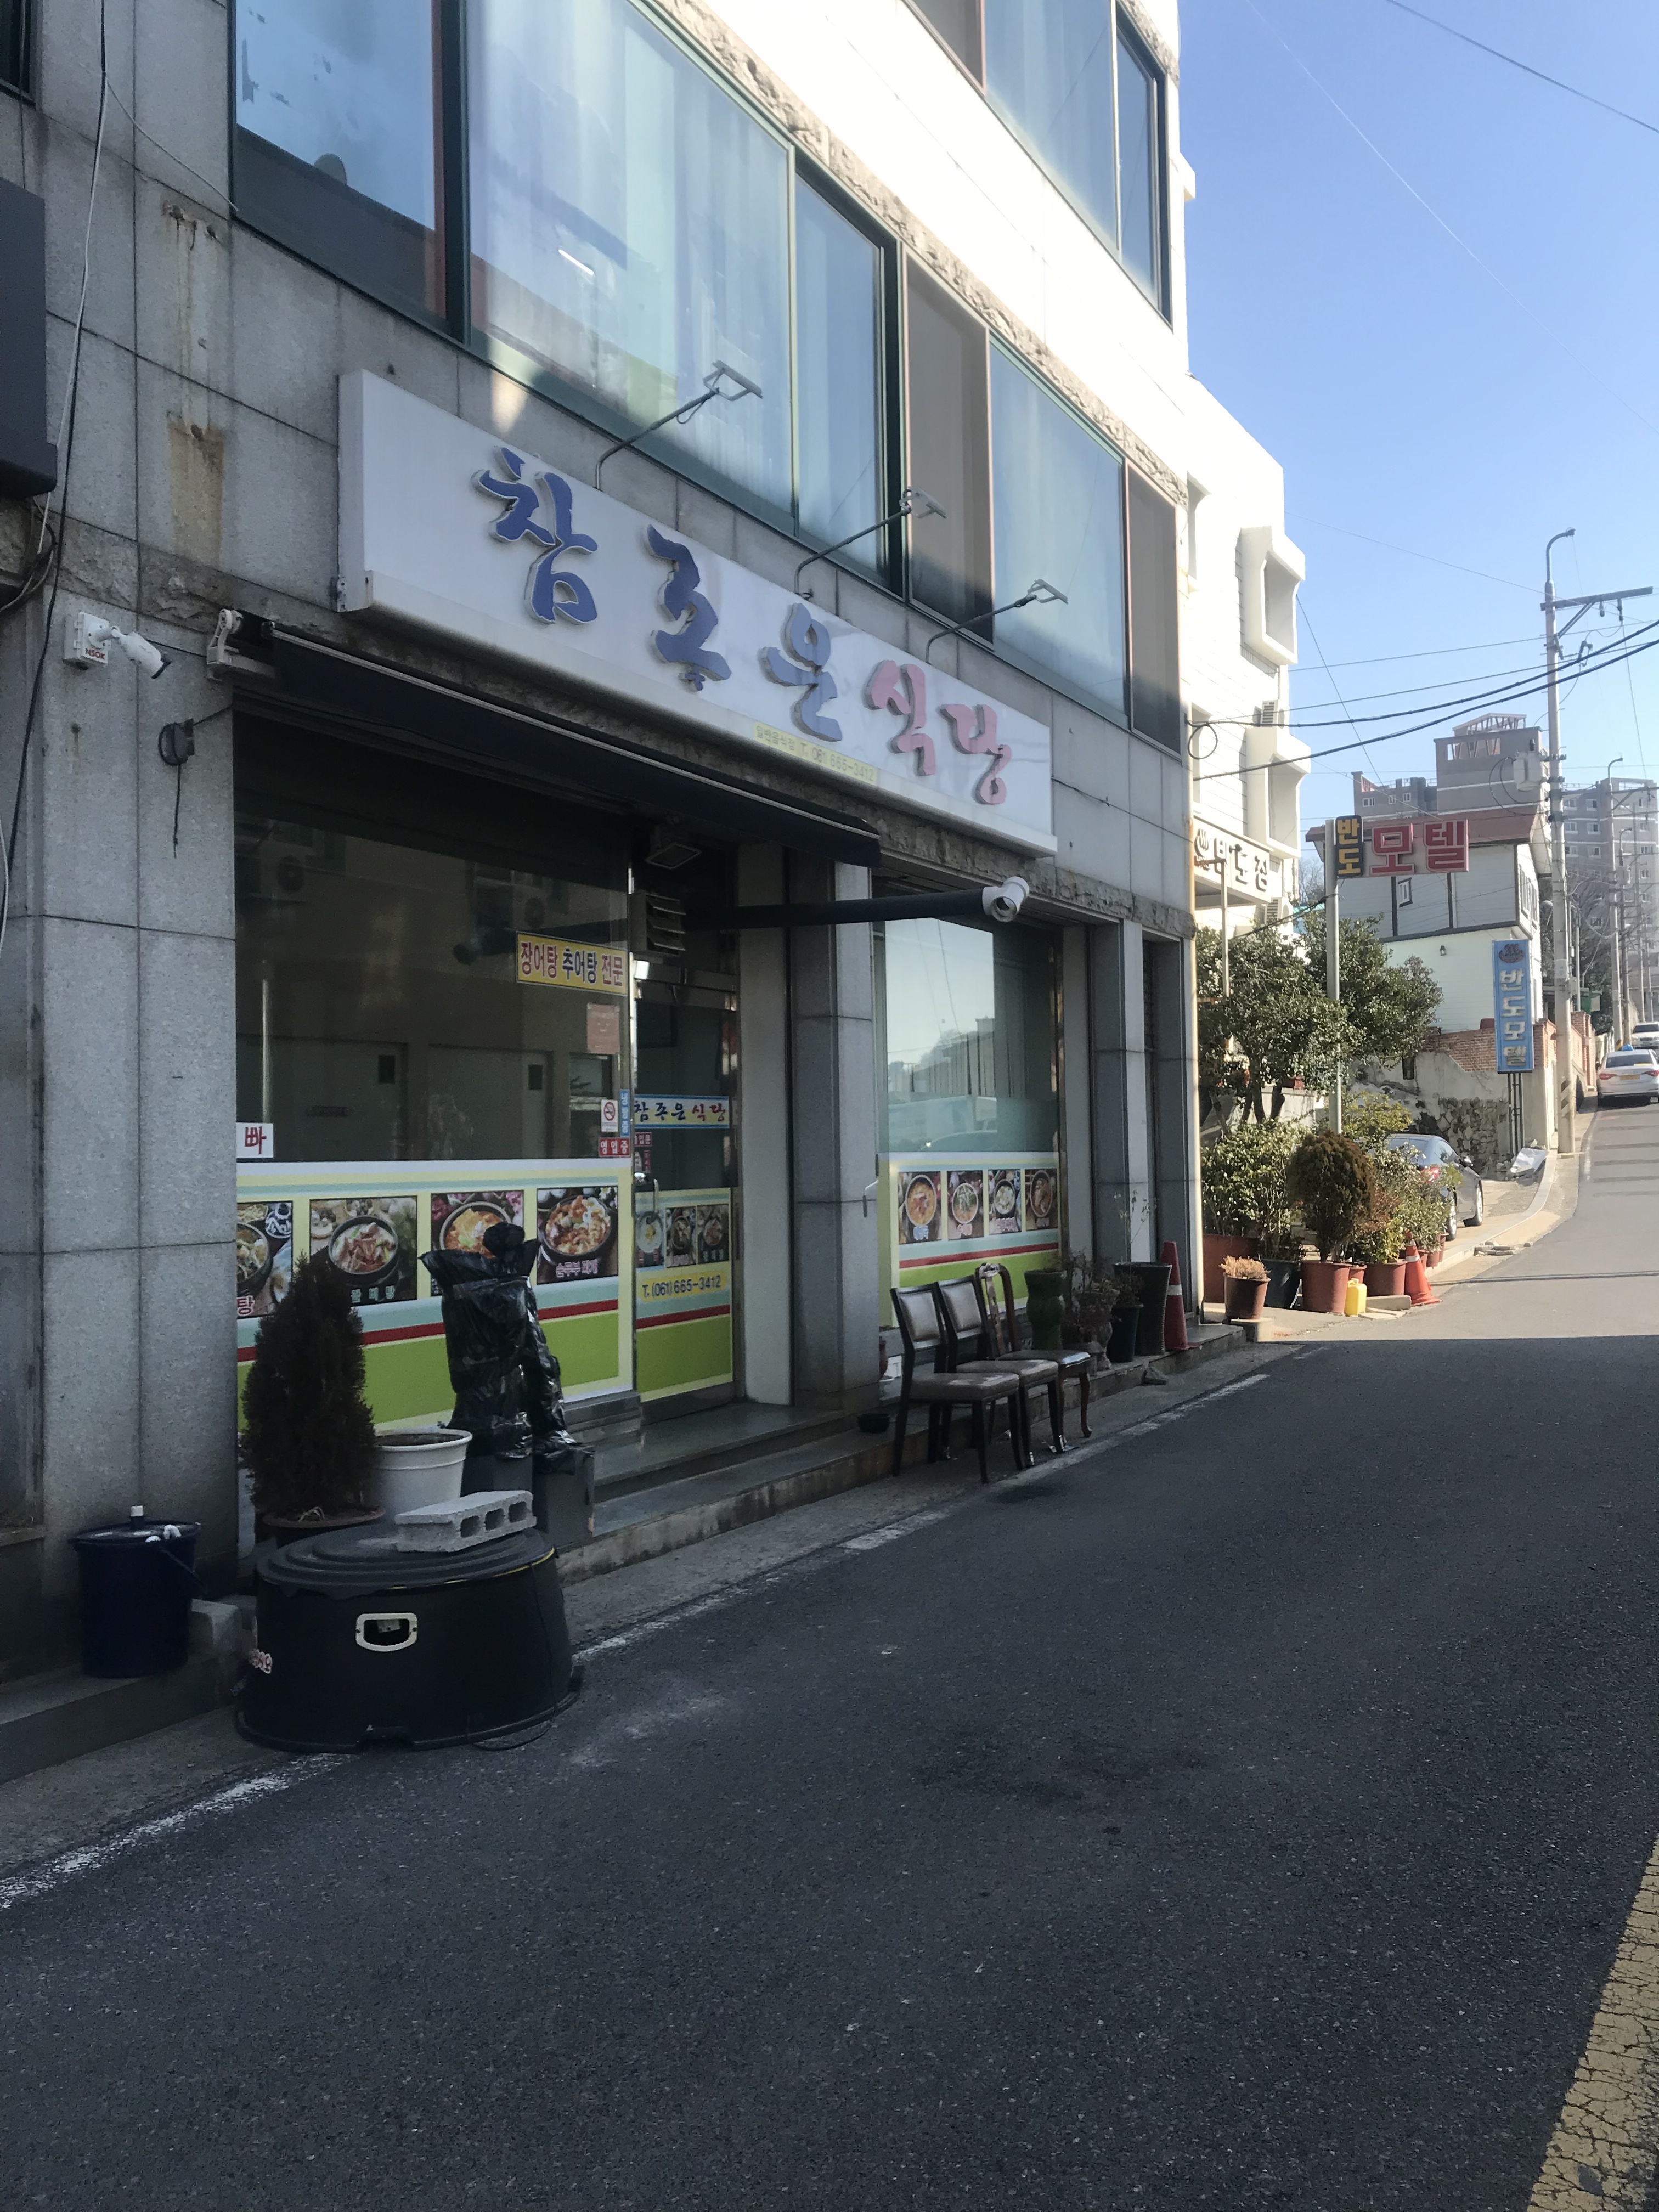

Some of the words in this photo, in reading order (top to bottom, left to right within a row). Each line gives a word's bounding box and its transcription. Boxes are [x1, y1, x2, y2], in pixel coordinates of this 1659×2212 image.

[471, 445, 598, 624] 참
[861, 659, 1012, 805] 식당
[755, 725, 795, 751] 일반음식점
[830, 754, 874, 782] 665-3412
[1338, 818, 1360, 874] 반도
[1371, 820, 1468, 875] 모텔
[521, 941, 558, 978] 장어탕
[562, 947, 597, 984] 추어탕
[601, 955, 623, 986] 전문
[1500, 968, 1527, 1066] 반도모텔
[634, 1101, 648, 1122] 참
[692, 1103, 725, 1122] 식당
[600, 1140, 628, 1154] 영업중
[556, 1262, 580, 1278] 순두부
